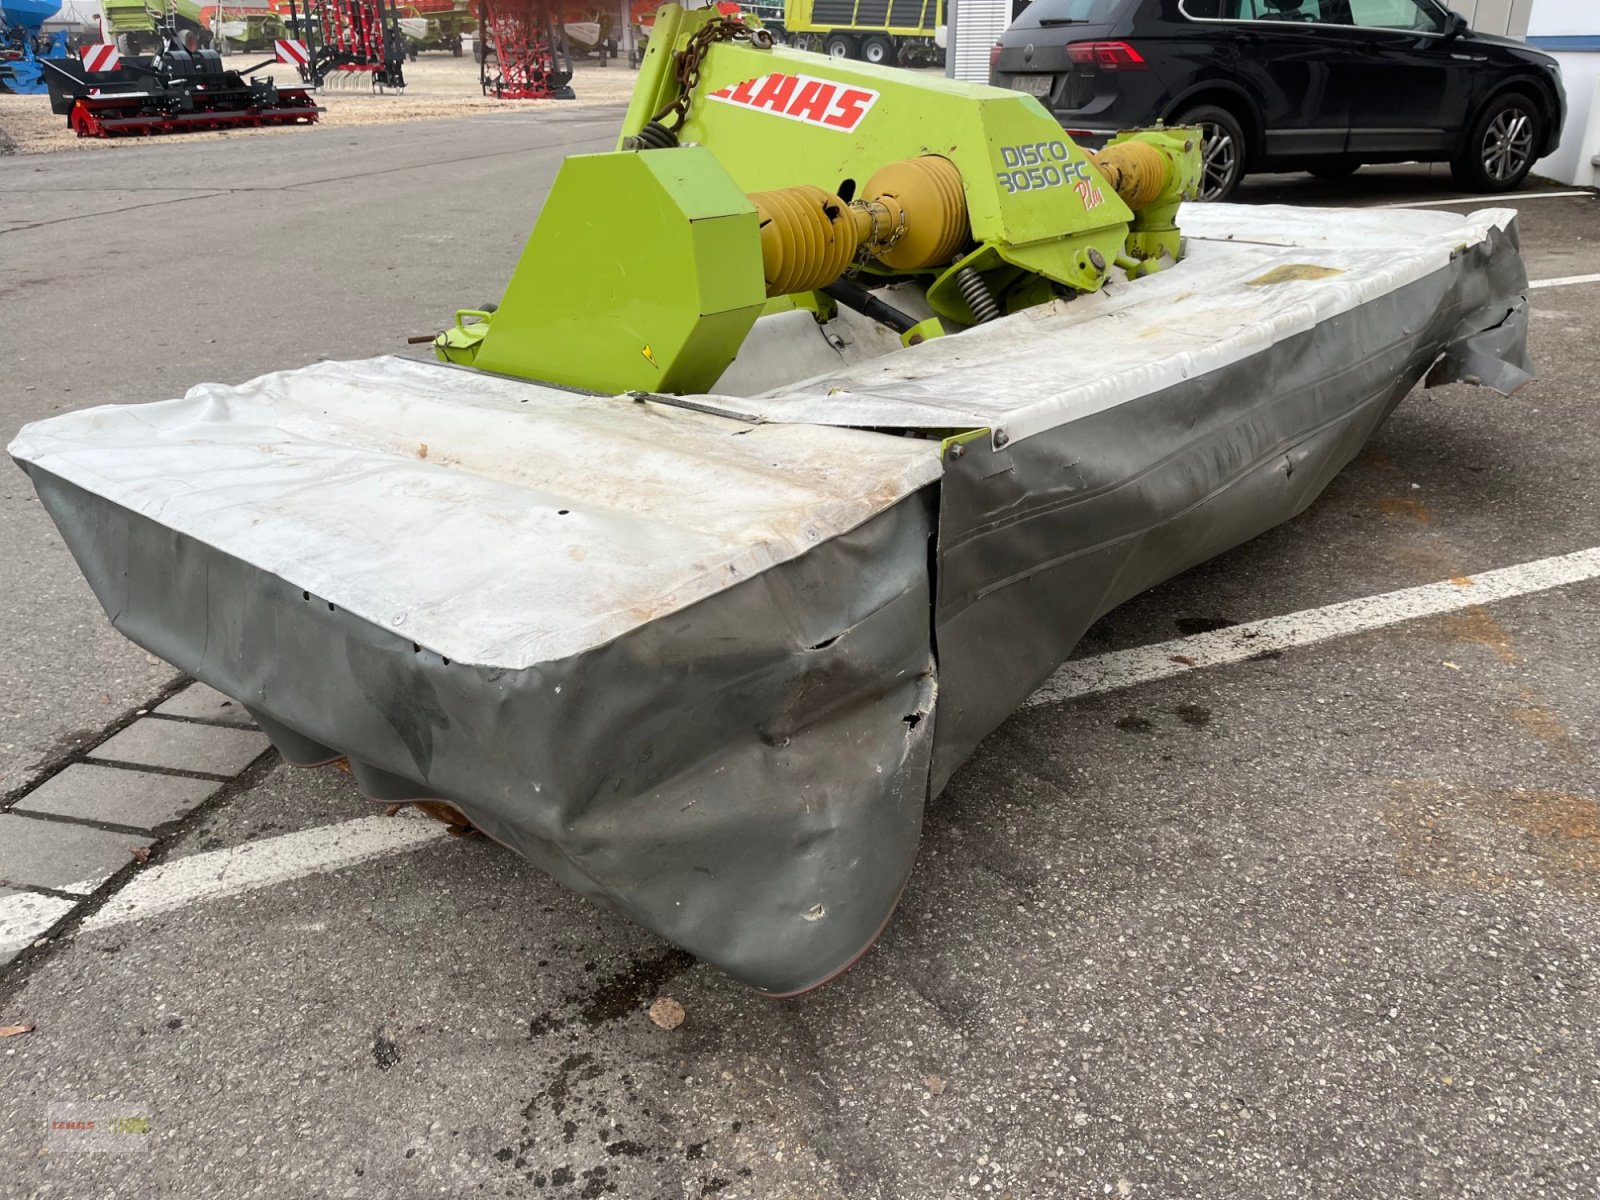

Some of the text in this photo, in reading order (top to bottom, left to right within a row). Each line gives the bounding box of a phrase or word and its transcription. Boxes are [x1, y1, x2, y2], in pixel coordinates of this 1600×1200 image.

[1000, 141, 1069, 168] DISCO
[997, 161, 1092, 194] 3050 FC
[1073, 179, 1104, 212] Plus
